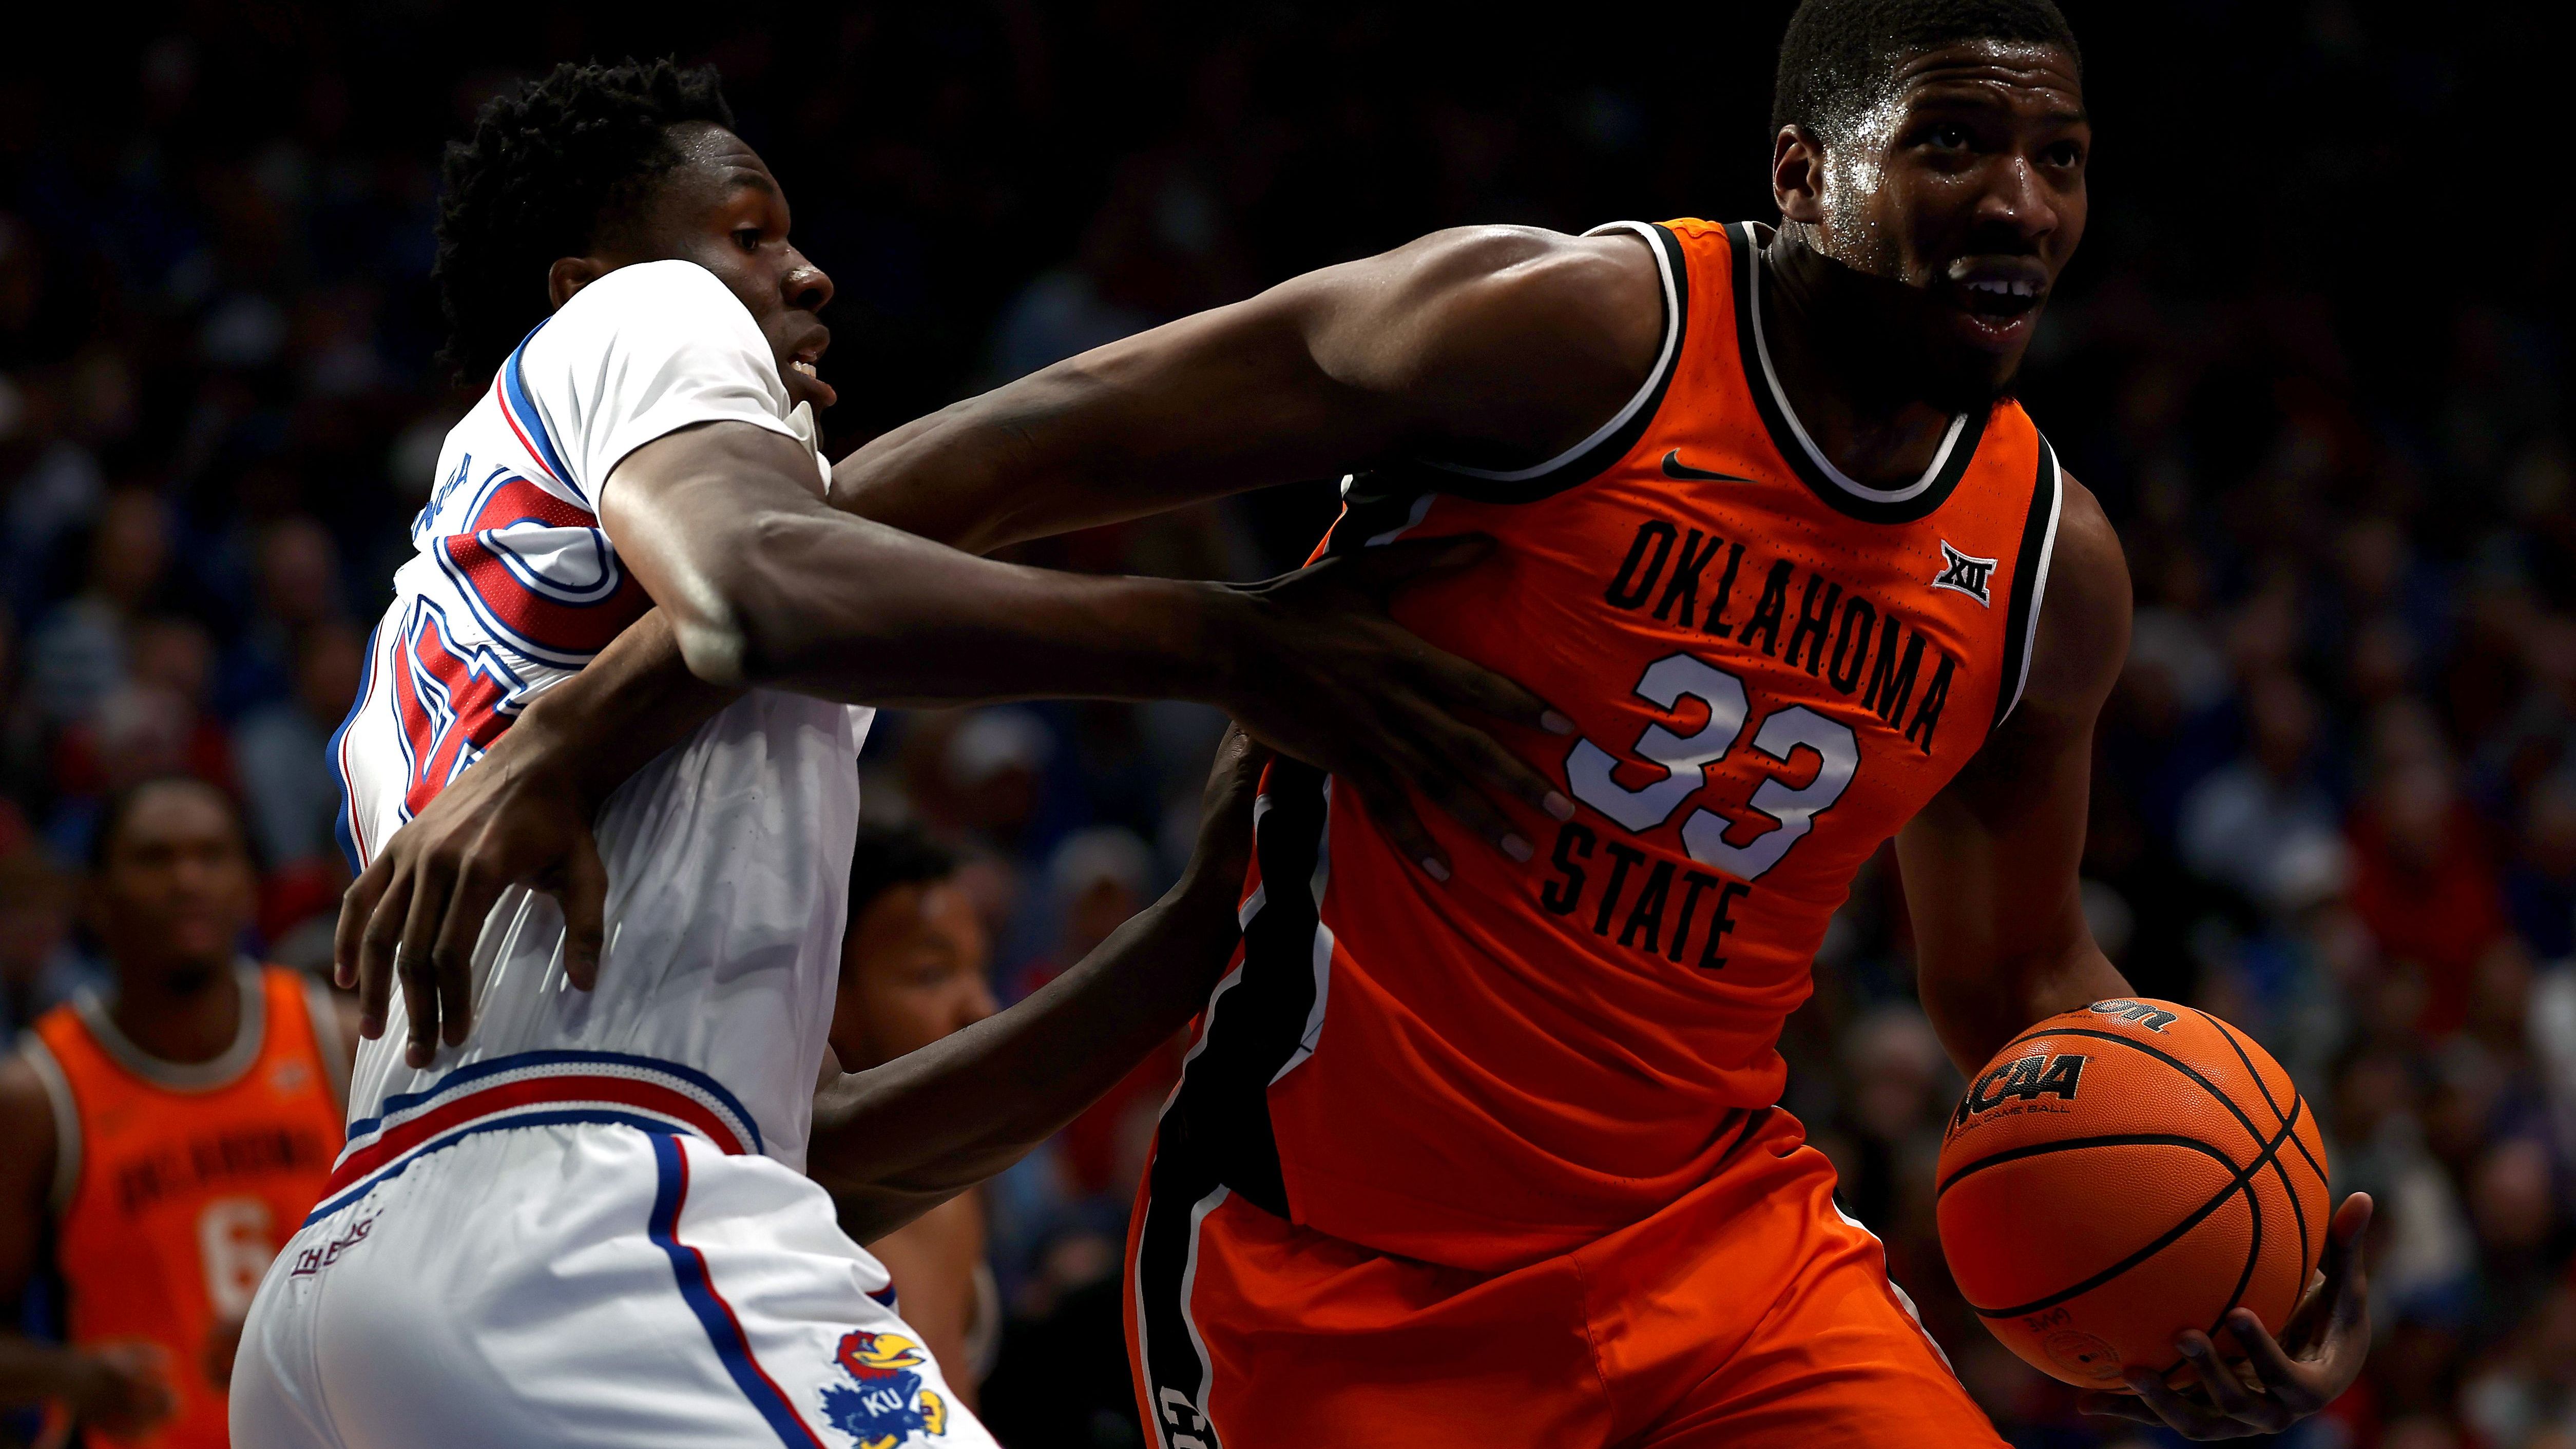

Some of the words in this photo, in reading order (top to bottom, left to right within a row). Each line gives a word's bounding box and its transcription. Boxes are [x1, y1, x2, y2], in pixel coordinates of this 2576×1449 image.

[1603, 519, 1956, 756] OKLAHOMA
[1563, 650, 1862, 882] 33
[1541, 822, 1751, 969] STATE
[2027, 1105, 2071, 1114] BALL
[861, 1387, 904, 1417] KU
